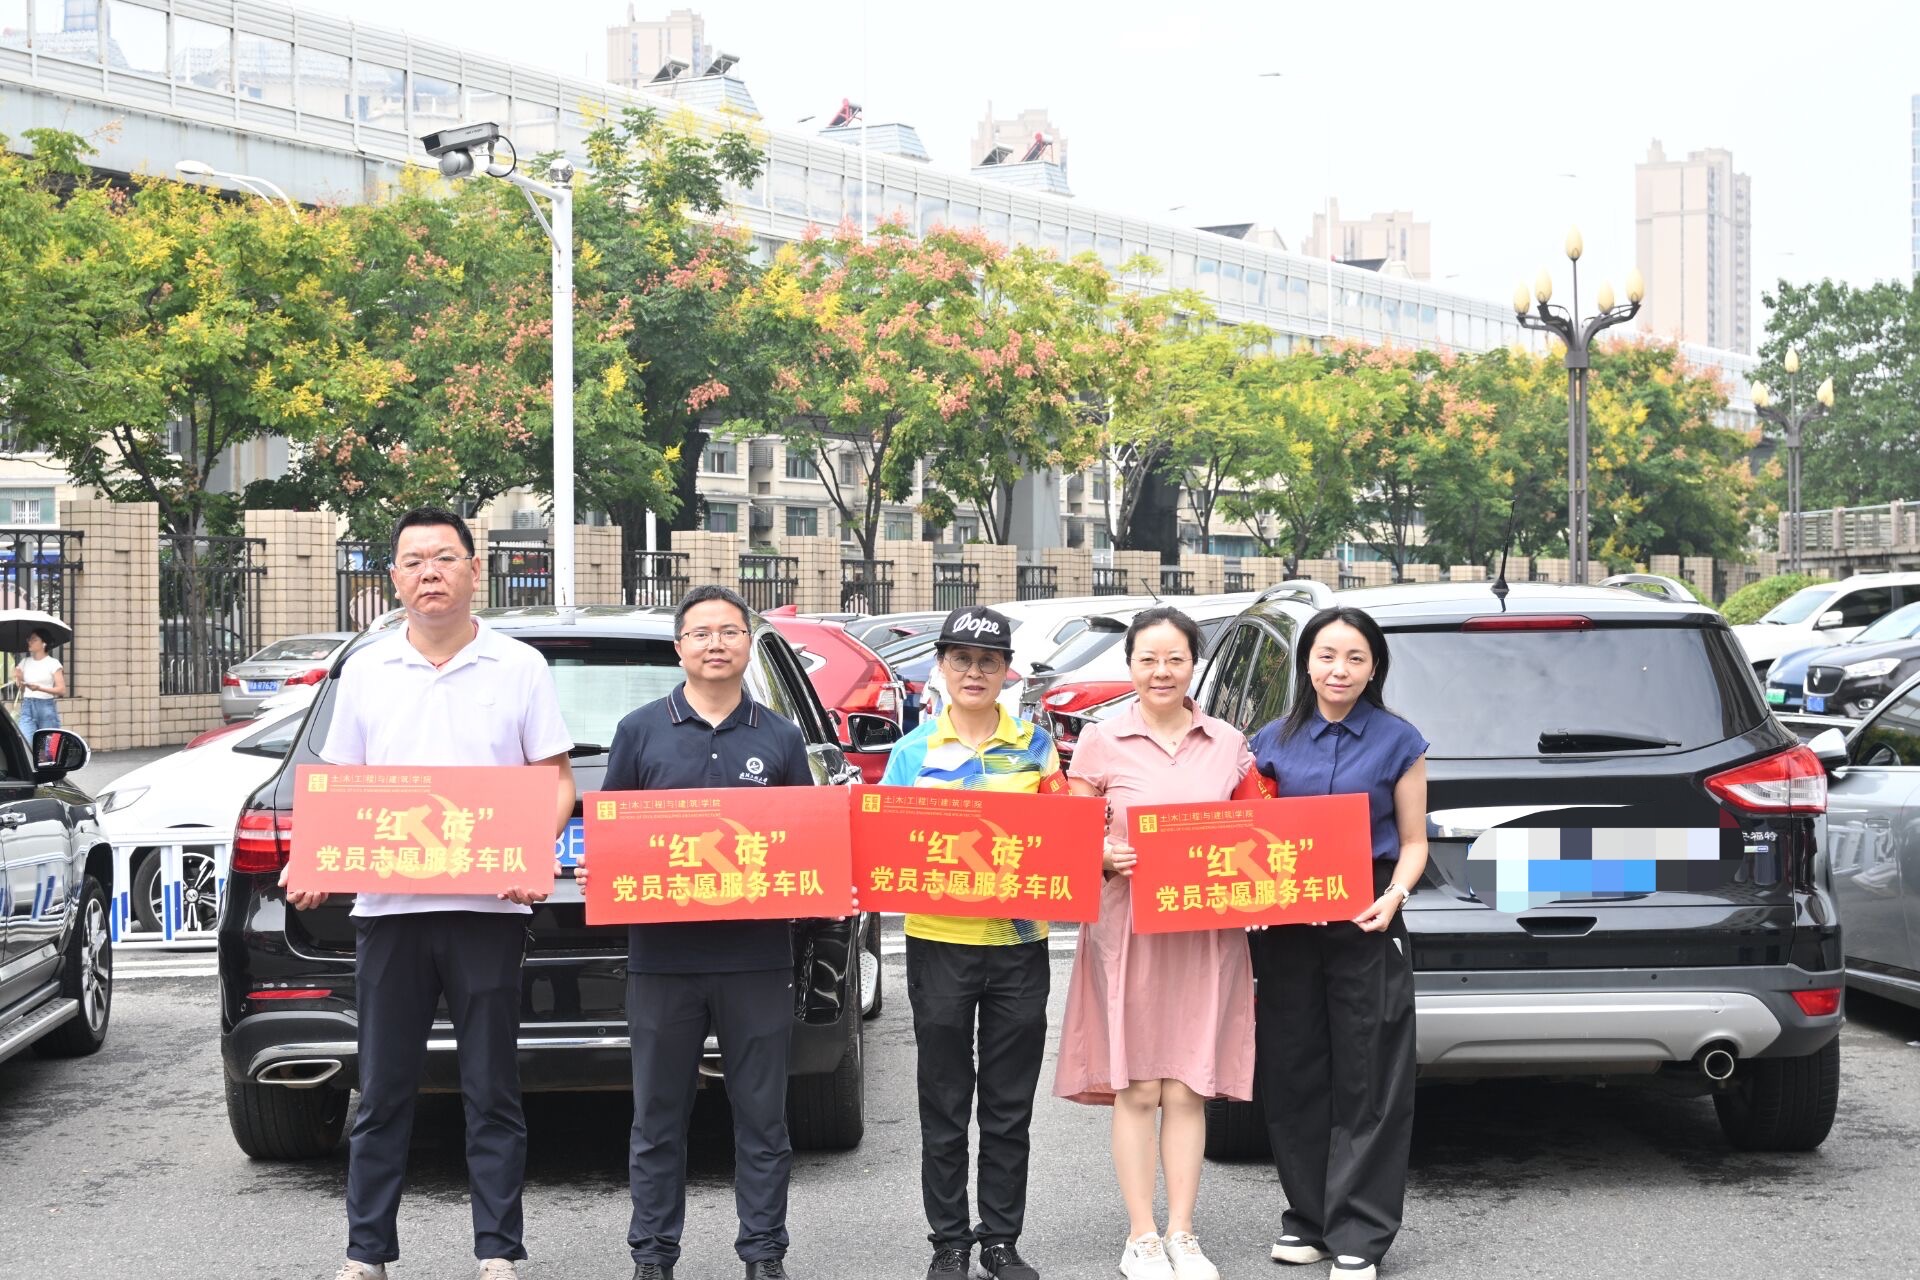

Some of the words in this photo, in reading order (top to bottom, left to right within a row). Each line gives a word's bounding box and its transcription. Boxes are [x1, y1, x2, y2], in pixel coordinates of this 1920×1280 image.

[952, 612, 1000, 638] Dope
[316, 846, 528, 873] 党员志愿服务车队
[612, 870, 824, 902] 党员志愿服务车队
[870, 866, 1073, 901] 党员志愿服务车队
[1156, 875, 1349, 912] 党员志愿服务车队
